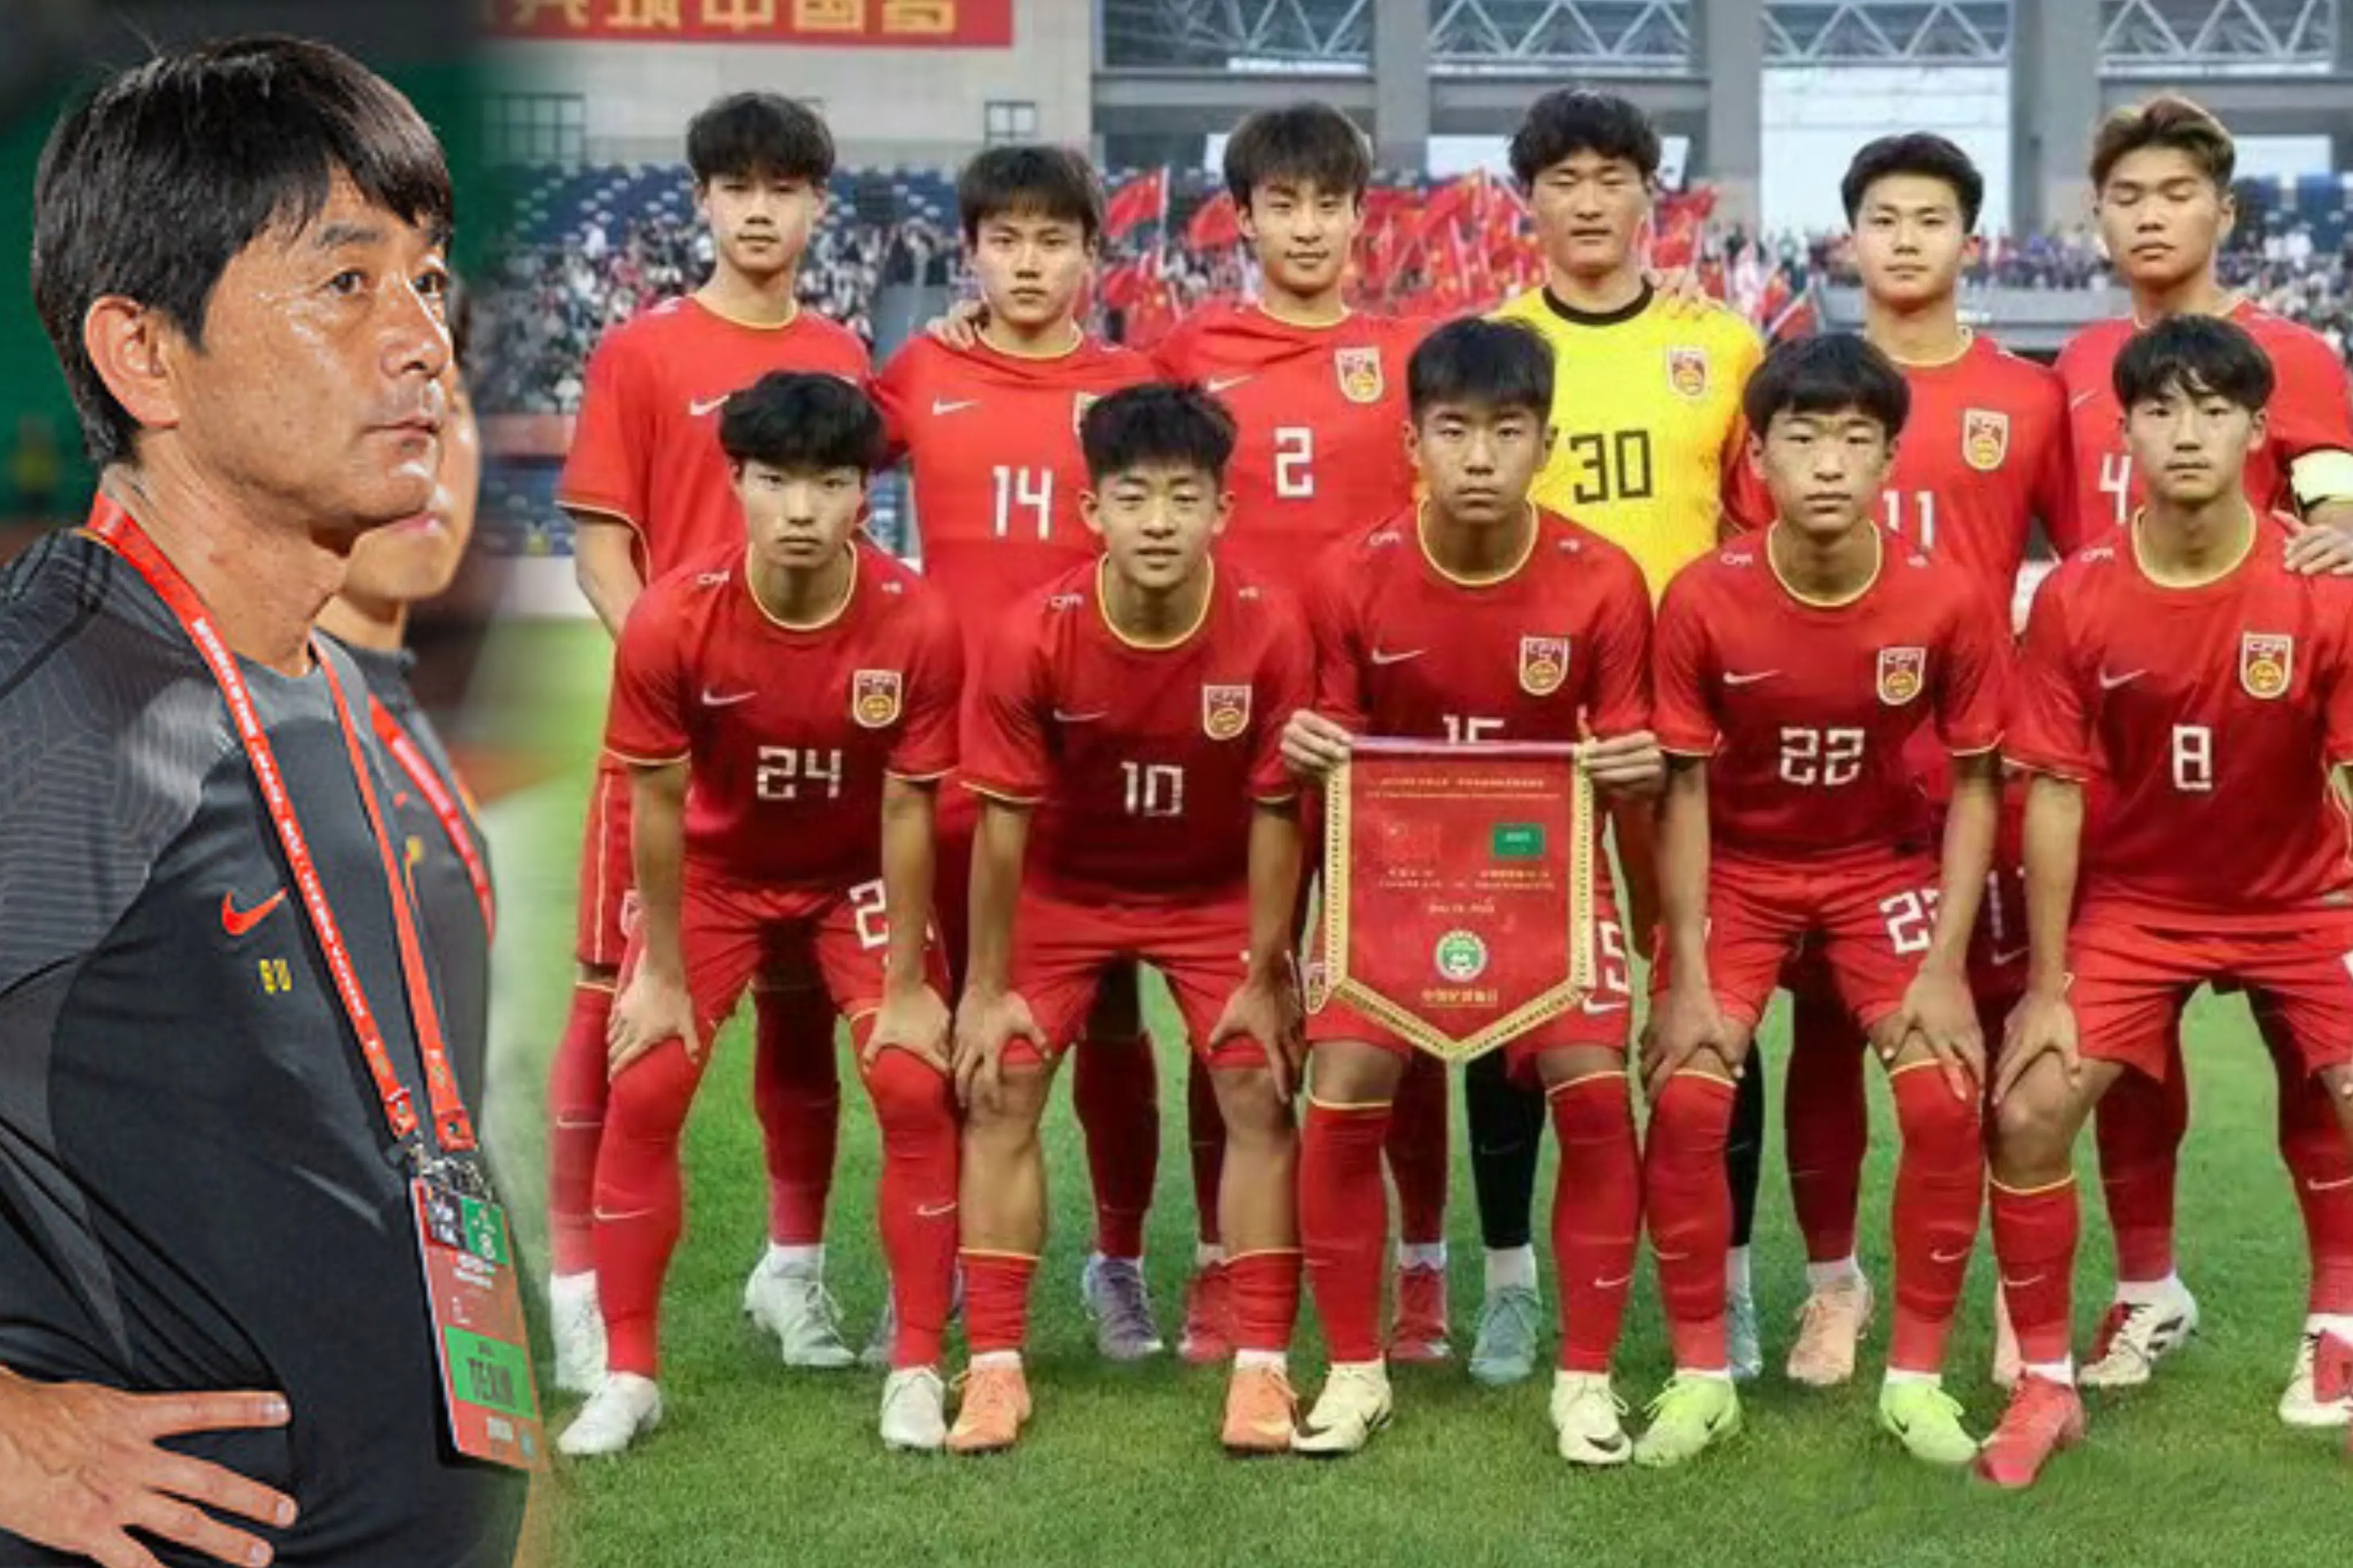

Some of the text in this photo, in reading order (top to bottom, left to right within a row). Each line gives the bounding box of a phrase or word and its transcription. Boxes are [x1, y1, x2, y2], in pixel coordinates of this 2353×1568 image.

[1274, 427, 1313, 498] 2
[1569, 430, 1653, 505] 30
[993, 465, 1053, 540] 14
[1883, 490, 1934, 550] 11
[757, 746, 842, 799] 24
[1121, 761, 1183, 817] 10
[1780, 727, 1865, 786] 22
[2172, 723, 2212, 791] 8
[849, 879, 889, 949] 2
